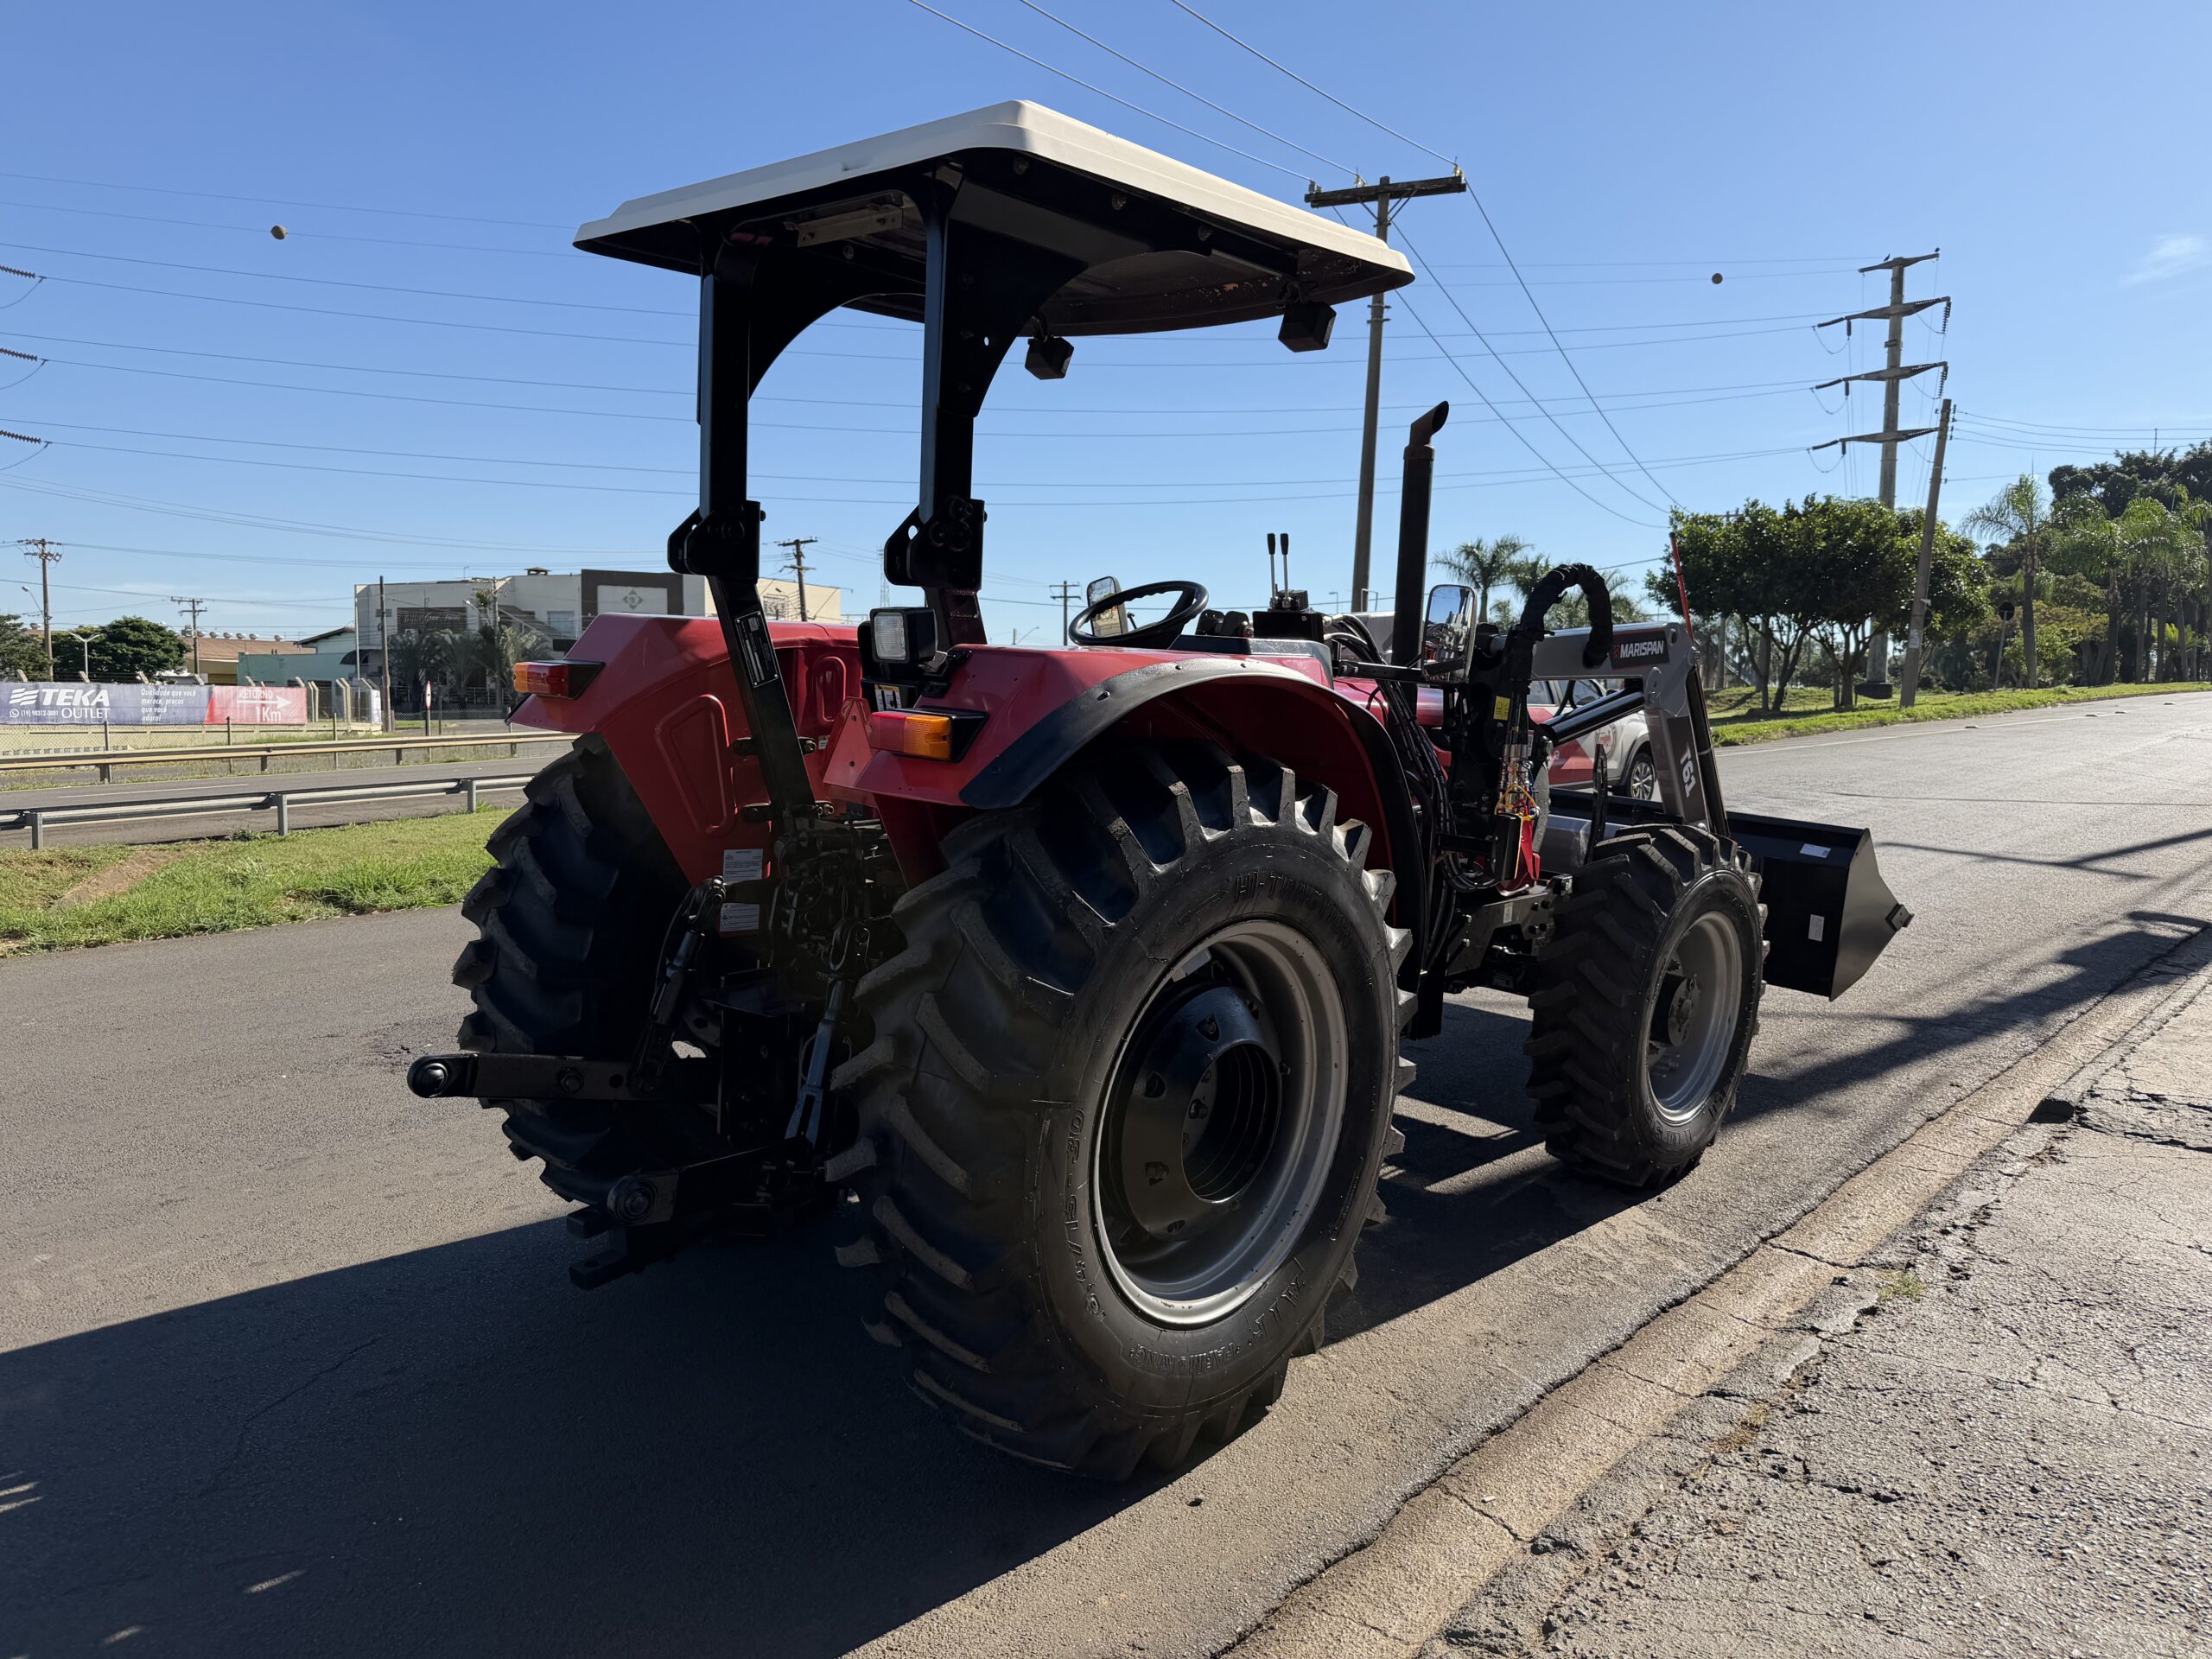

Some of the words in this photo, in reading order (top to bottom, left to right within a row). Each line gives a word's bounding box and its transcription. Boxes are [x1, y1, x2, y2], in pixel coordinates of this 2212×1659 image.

[1620, 640, 1664, 658] MARISPAN
[41, 689, 110, 706] TEKA
[141, 688, 170, 696] Qualidade
[238, 690, 274, 699] RETORNO
[21, 710, 31, 719] (19)
[61, 707, 111, 718] OUTLET
[1680, 743, 1696, 798] T61
